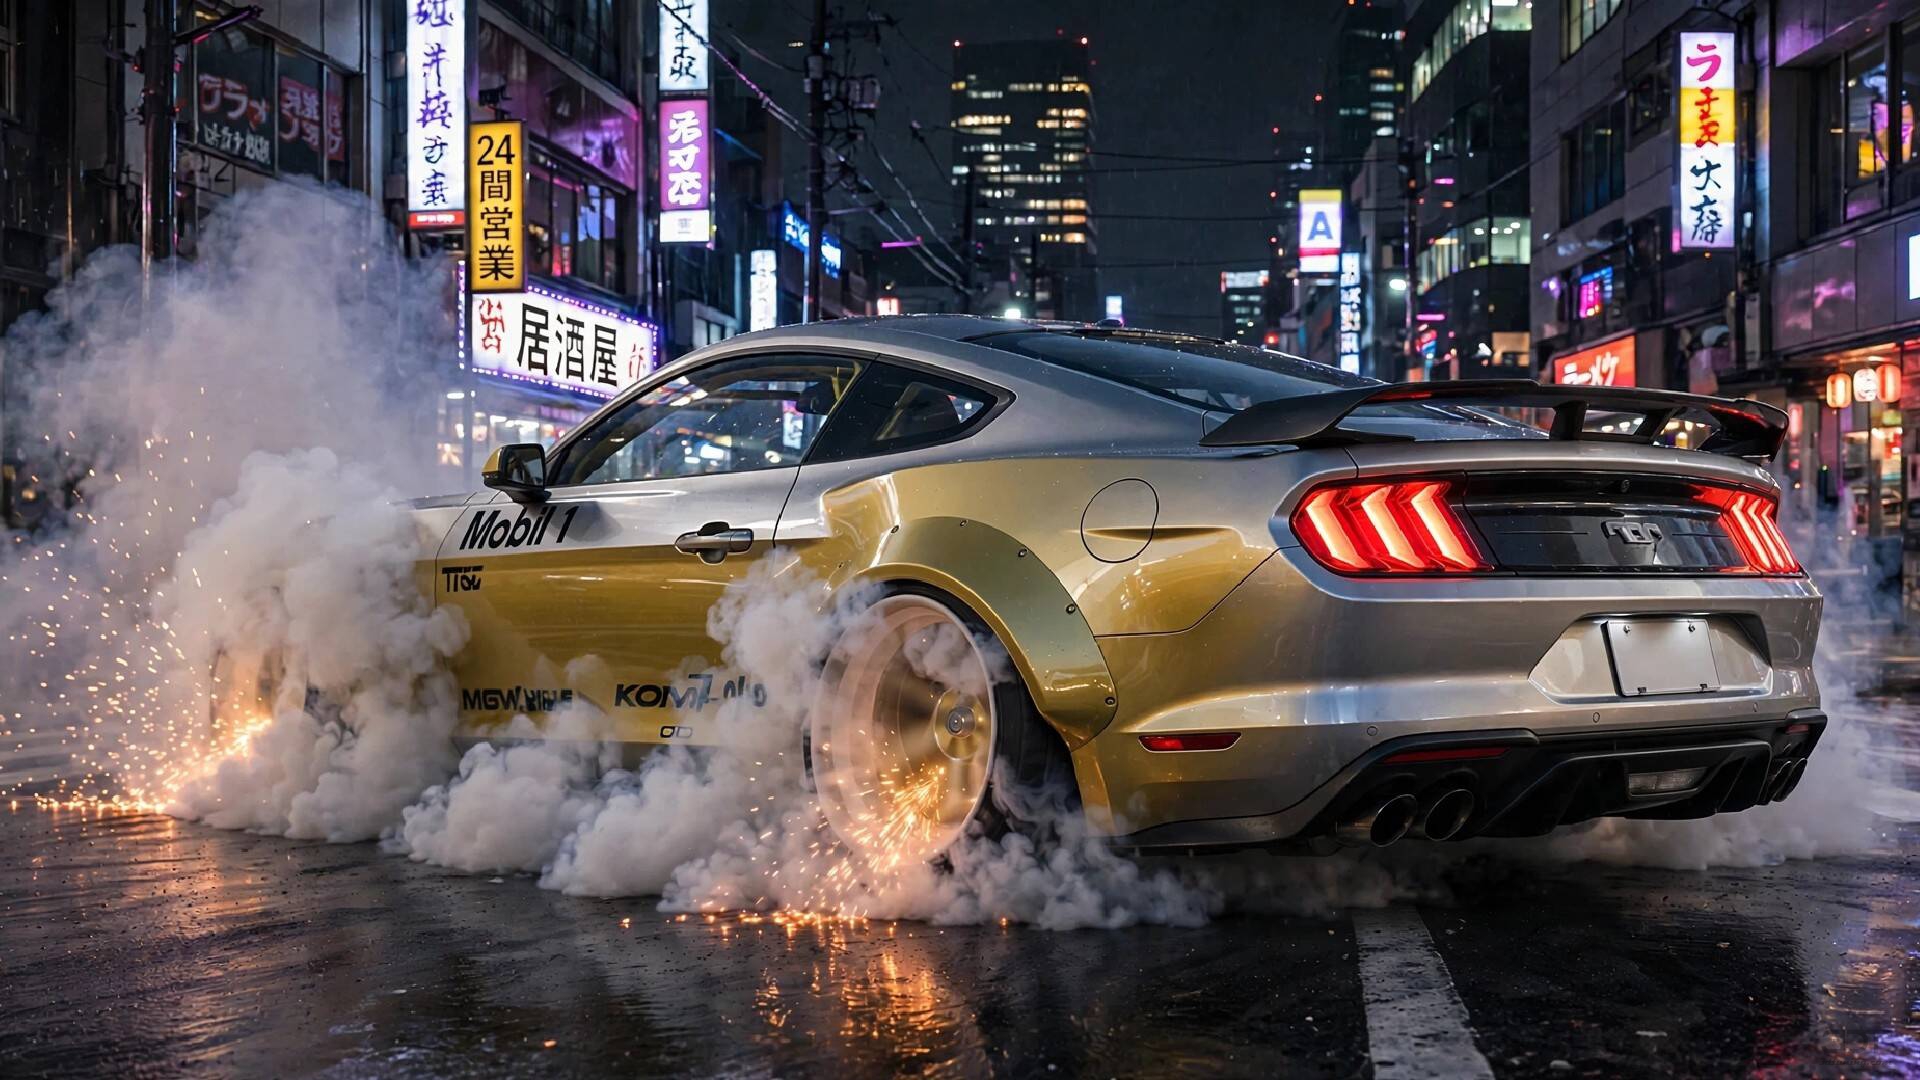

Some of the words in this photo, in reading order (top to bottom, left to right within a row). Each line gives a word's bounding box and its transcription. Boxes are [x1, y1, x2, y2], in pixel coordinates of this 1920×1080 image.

[476, 134, 515, 281] 24間営業
[1308, 211, 1333, 240] A
[517, 303, 618, 387] 居酒屋
[459, 505, 557, 550] Mobil
[556, 506, 579, 543] 1
